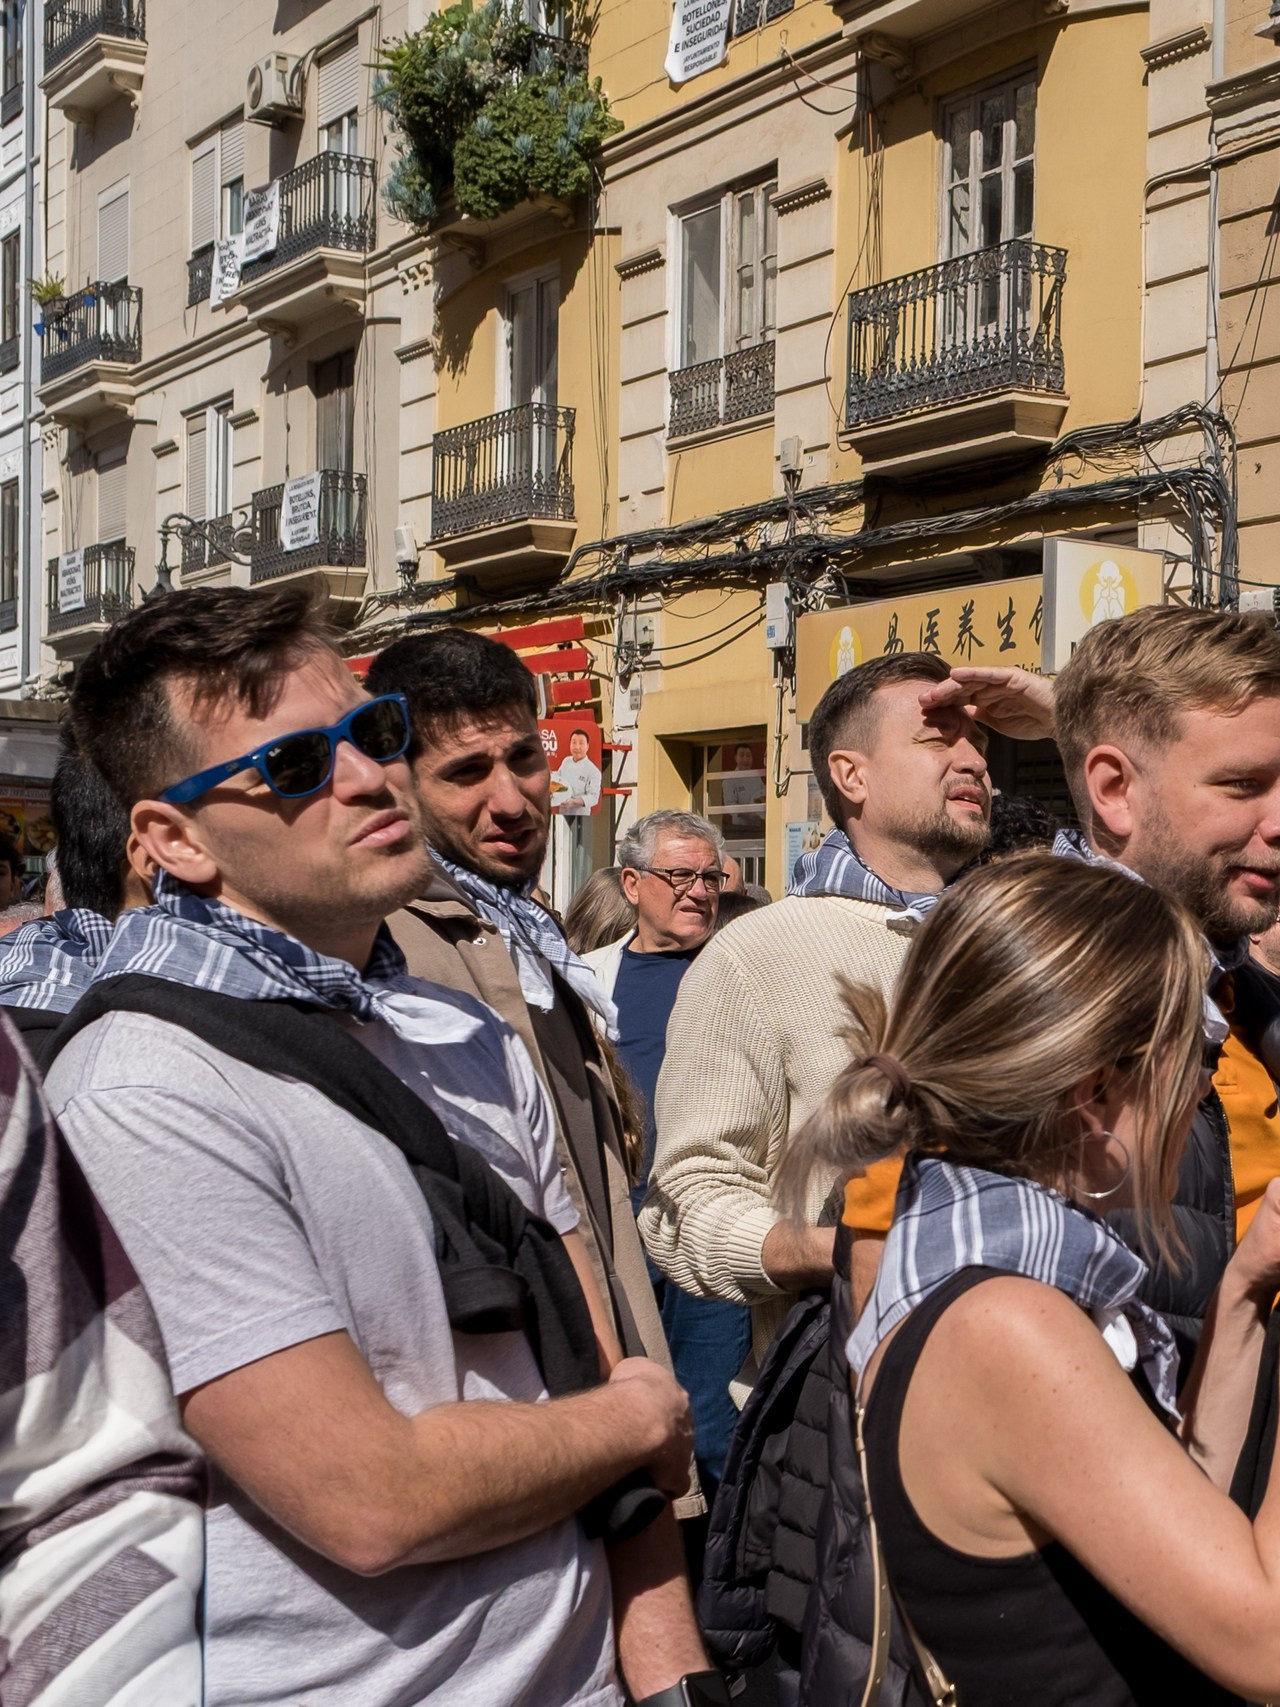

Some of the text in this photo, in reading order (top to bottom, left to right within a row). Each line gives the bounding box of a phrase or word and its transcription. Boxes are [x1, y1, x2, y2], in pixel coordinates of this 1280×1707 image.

[686, 10, 720, 36] SUCIEDAD
[674, 42, 681, 53] E
[541, 729, 557, 740] SA
